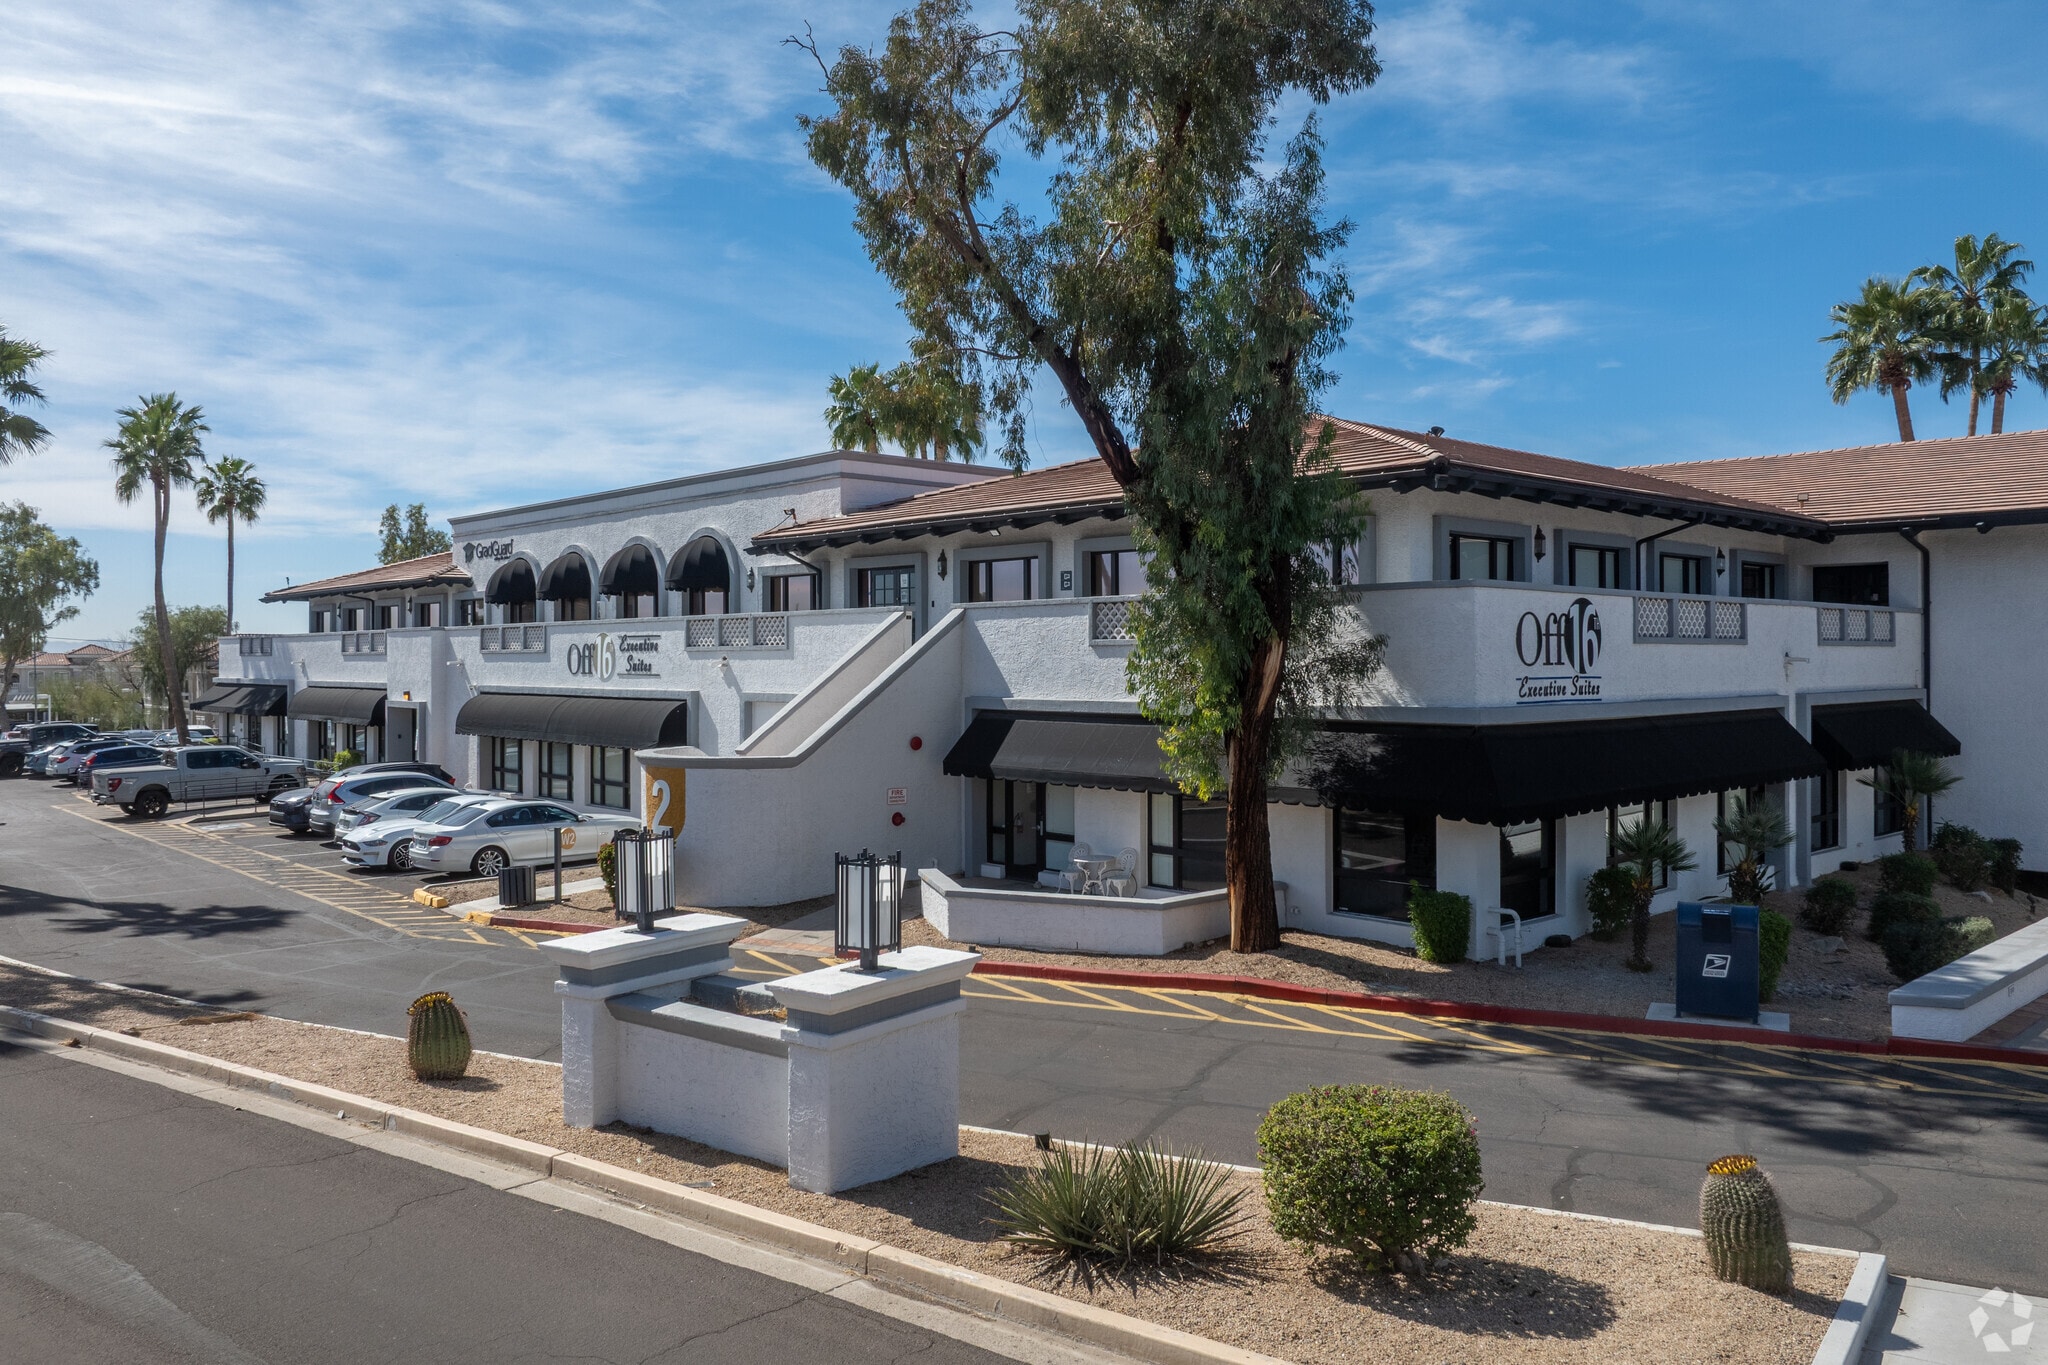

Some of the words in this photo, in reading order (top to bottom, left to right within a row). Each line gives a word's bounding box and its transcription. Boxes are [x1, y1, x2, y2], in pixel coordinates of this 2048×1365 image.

[476, 539, 514, 559] GradGuard
[619, 635, 659, 652] Executive
[625, 654, 652, 672] Suites
[1518, 676, 1567, 698] Executive
[1570, 675, 1600, 696] Suites
[652, 779, 673, 834] 2
[561, 833, 575, 846] W2
